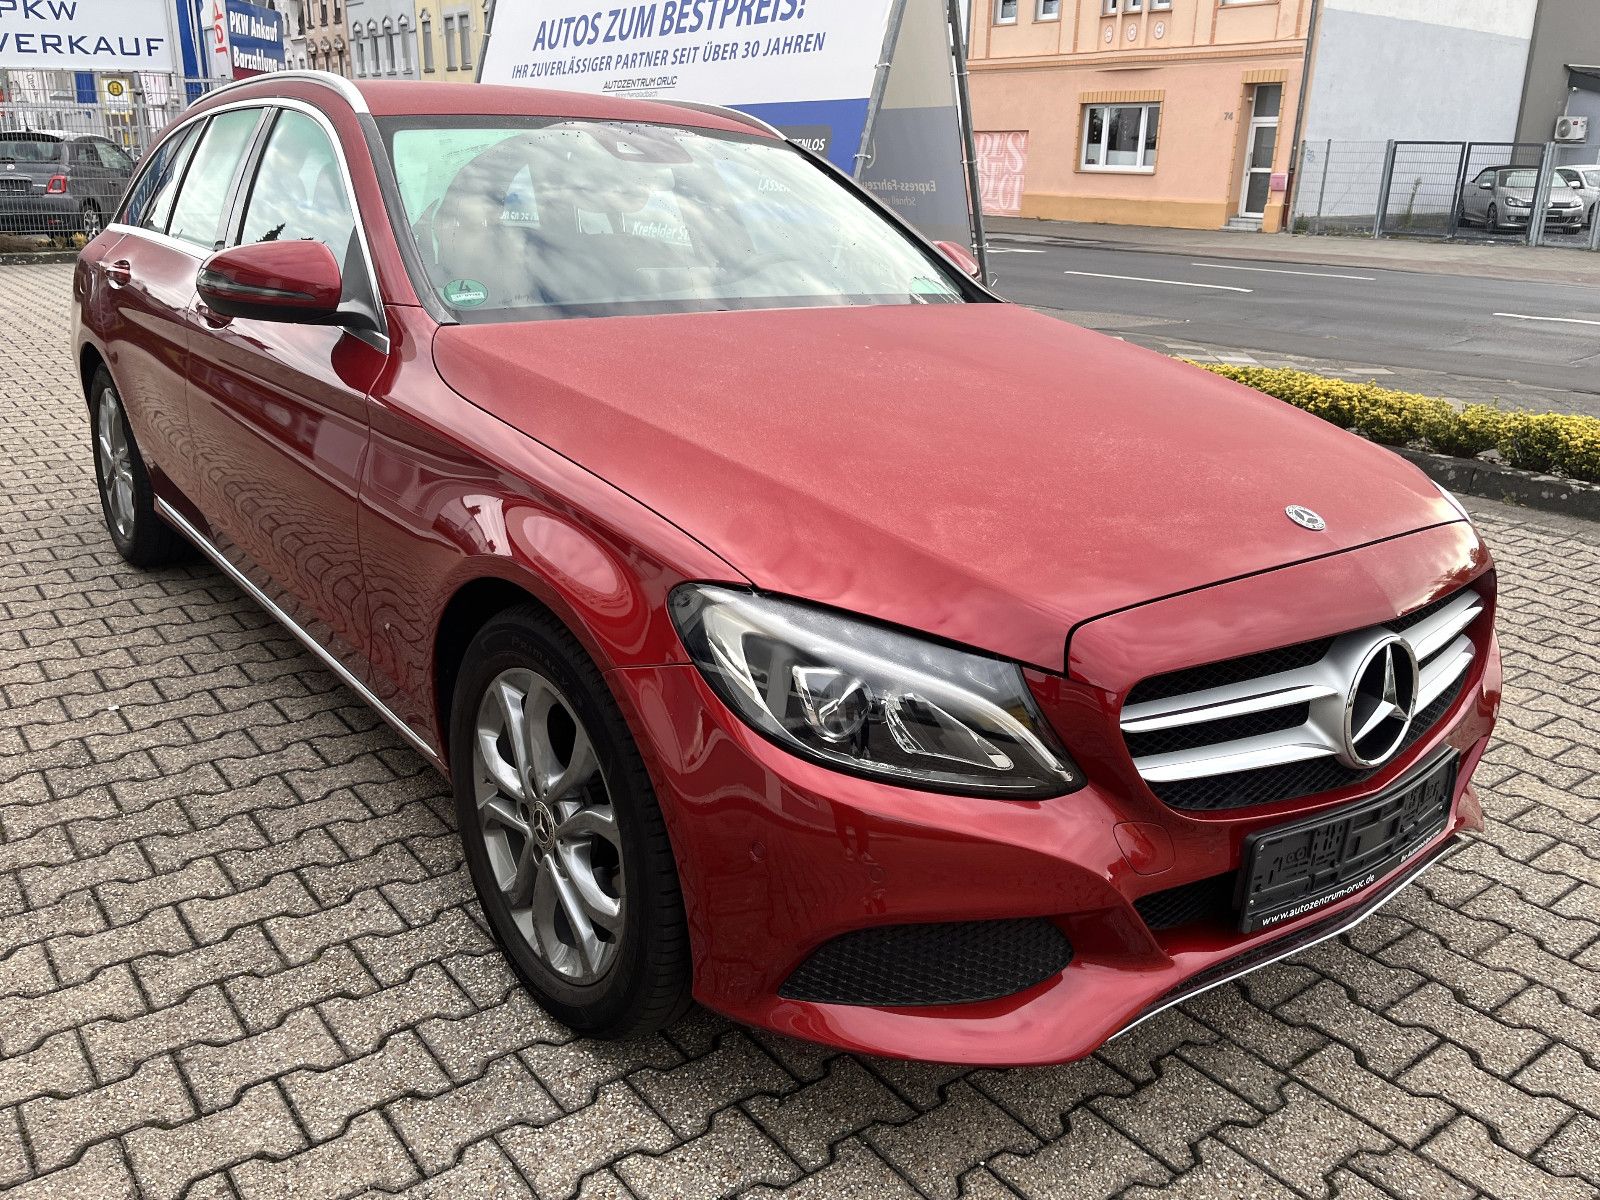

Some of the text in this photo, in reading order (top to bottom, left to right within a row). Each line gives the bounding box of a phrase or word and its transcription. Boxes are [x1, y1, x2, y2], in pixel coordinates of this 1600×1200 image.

[0, 0, 77, 21] PKW
[229, 10, 249, 36] PKW
[251, 16, 278, 42] Ankauf
[532, 12, 602, 51] AUTOS
[603, 3, 657, 43] ZUM
[233, 45, 278, 73] Barzahlung
[512, 32, 827, 79] IHR ZUVERLÄSSIGER PARTNER SEIT ÜBER 30 JAHREN
[603, 75, 678, 90] AUTOZENTRUM ORUC
[1261, 873, 1376, 926] www.autozentrum-oruc.de
